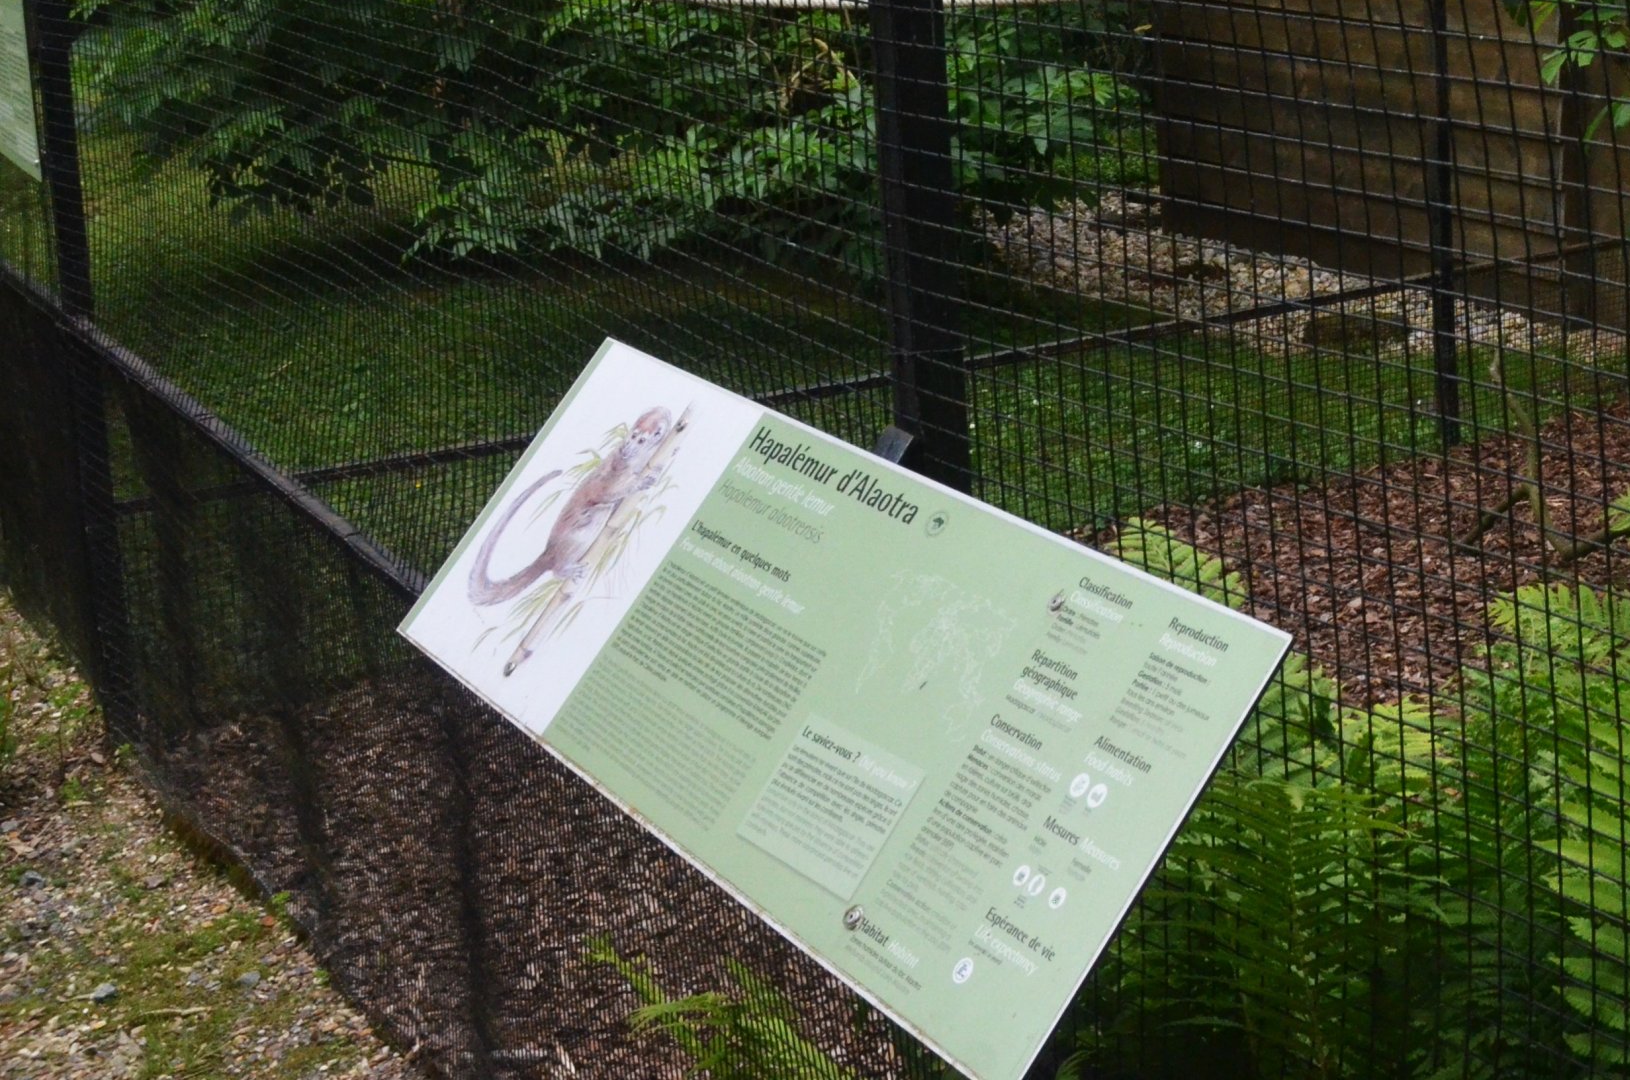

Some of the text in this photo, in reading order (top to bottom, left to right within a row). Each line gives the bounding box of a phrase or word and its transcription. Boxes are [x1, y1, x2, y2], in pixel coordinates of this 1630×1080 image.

[750, 427, 918, 524] Hapalémur d'Alaotra
[768, 479, 805, 503] gentle
[801, 490, 835, 516] lemur
[691, 520, 791, 582] L'hapalémur en quelques mots
[1079, 577, 1133, 609] Classification
[1168, 617, 1229, 652] Reproduction
[1031, 649, 1078, 680] Répartition
[1021, 666, 1078, 700] géographique
[802, 726, 813, 739] Le
[811, 733, 853, 760] saviez-vous
[852, 751, 862, 763] ?
[990, 714, 1042, 750] Conservation
[1094, 736, 1152, 773] Alimentation
[1043, 816, 1080, 846] Mesures
[856, 916, 892, 948] Habitat
[985, 907, 1056, 962] Espérance de vie
